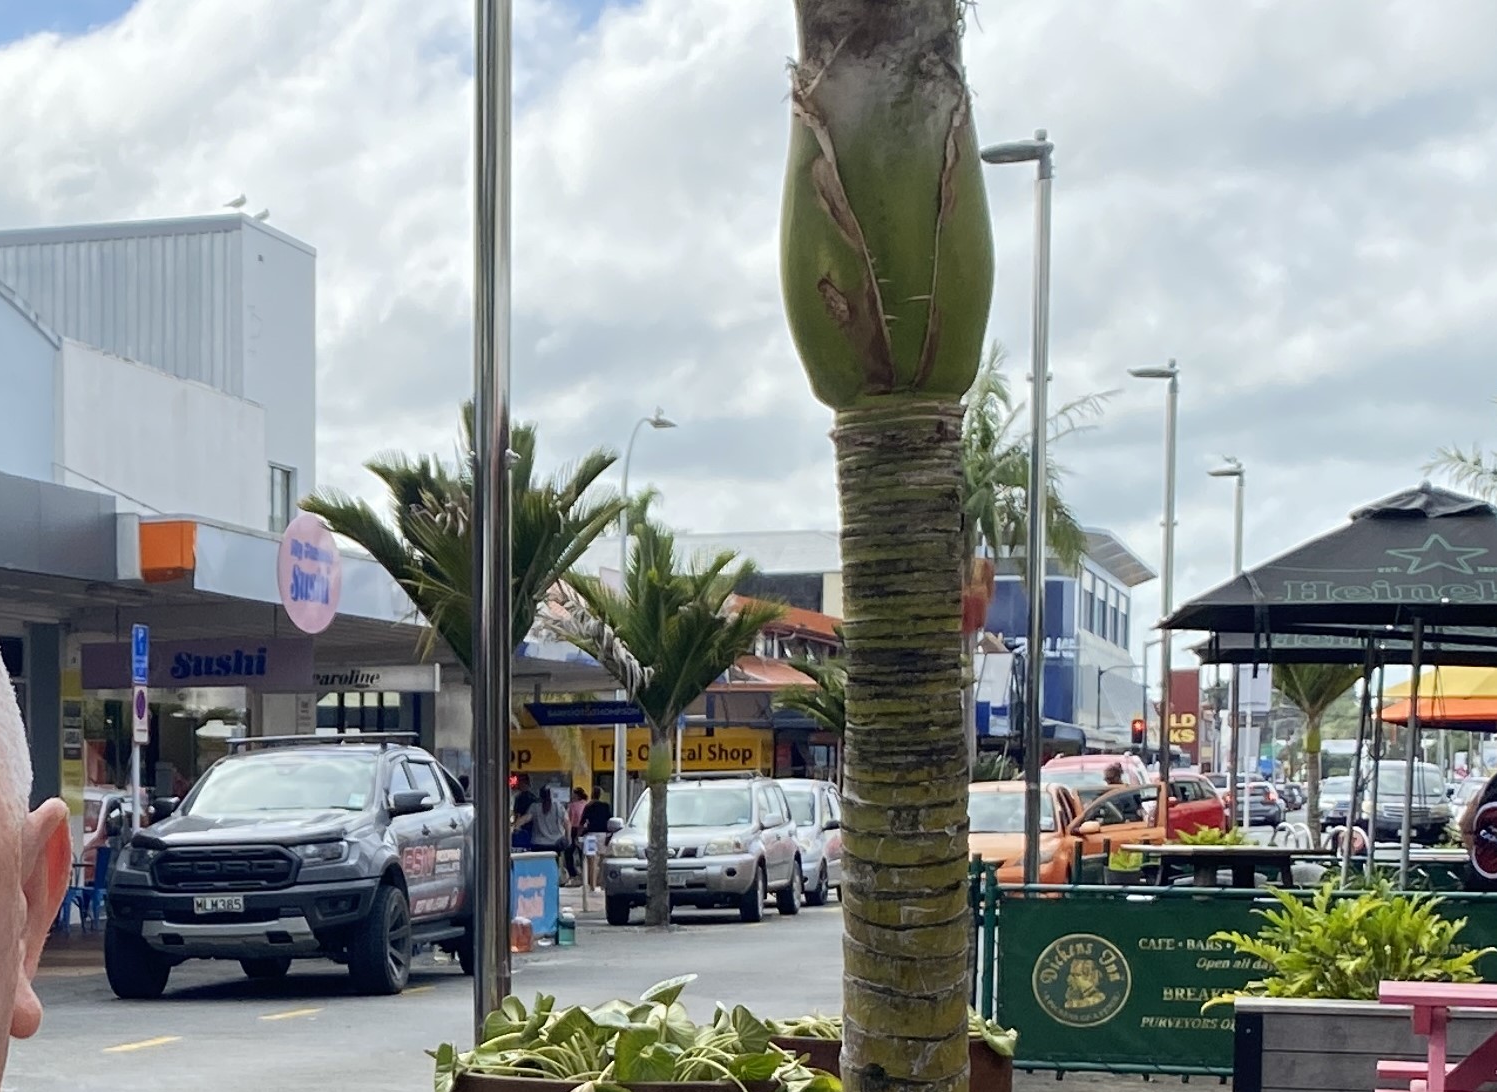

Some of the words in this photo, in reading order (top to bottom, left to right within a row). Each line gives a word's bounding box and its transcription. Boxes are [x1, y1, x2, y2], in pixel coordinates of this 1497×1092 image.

[171, 647, 267, 679] Sushi
[599, 744, 632, 762] Te
[638, 743, 702, 762] Oical
[708, 743, 753, 765] Shop
[167, 859, 290, 873] FORD
[1186, 939, 1223, 950] BARS
[1196, 957, 1230, 971] Open
[1233, 957, 1251, 969] all
[1140, 1016, 1217, 1029] PURVEYORS
